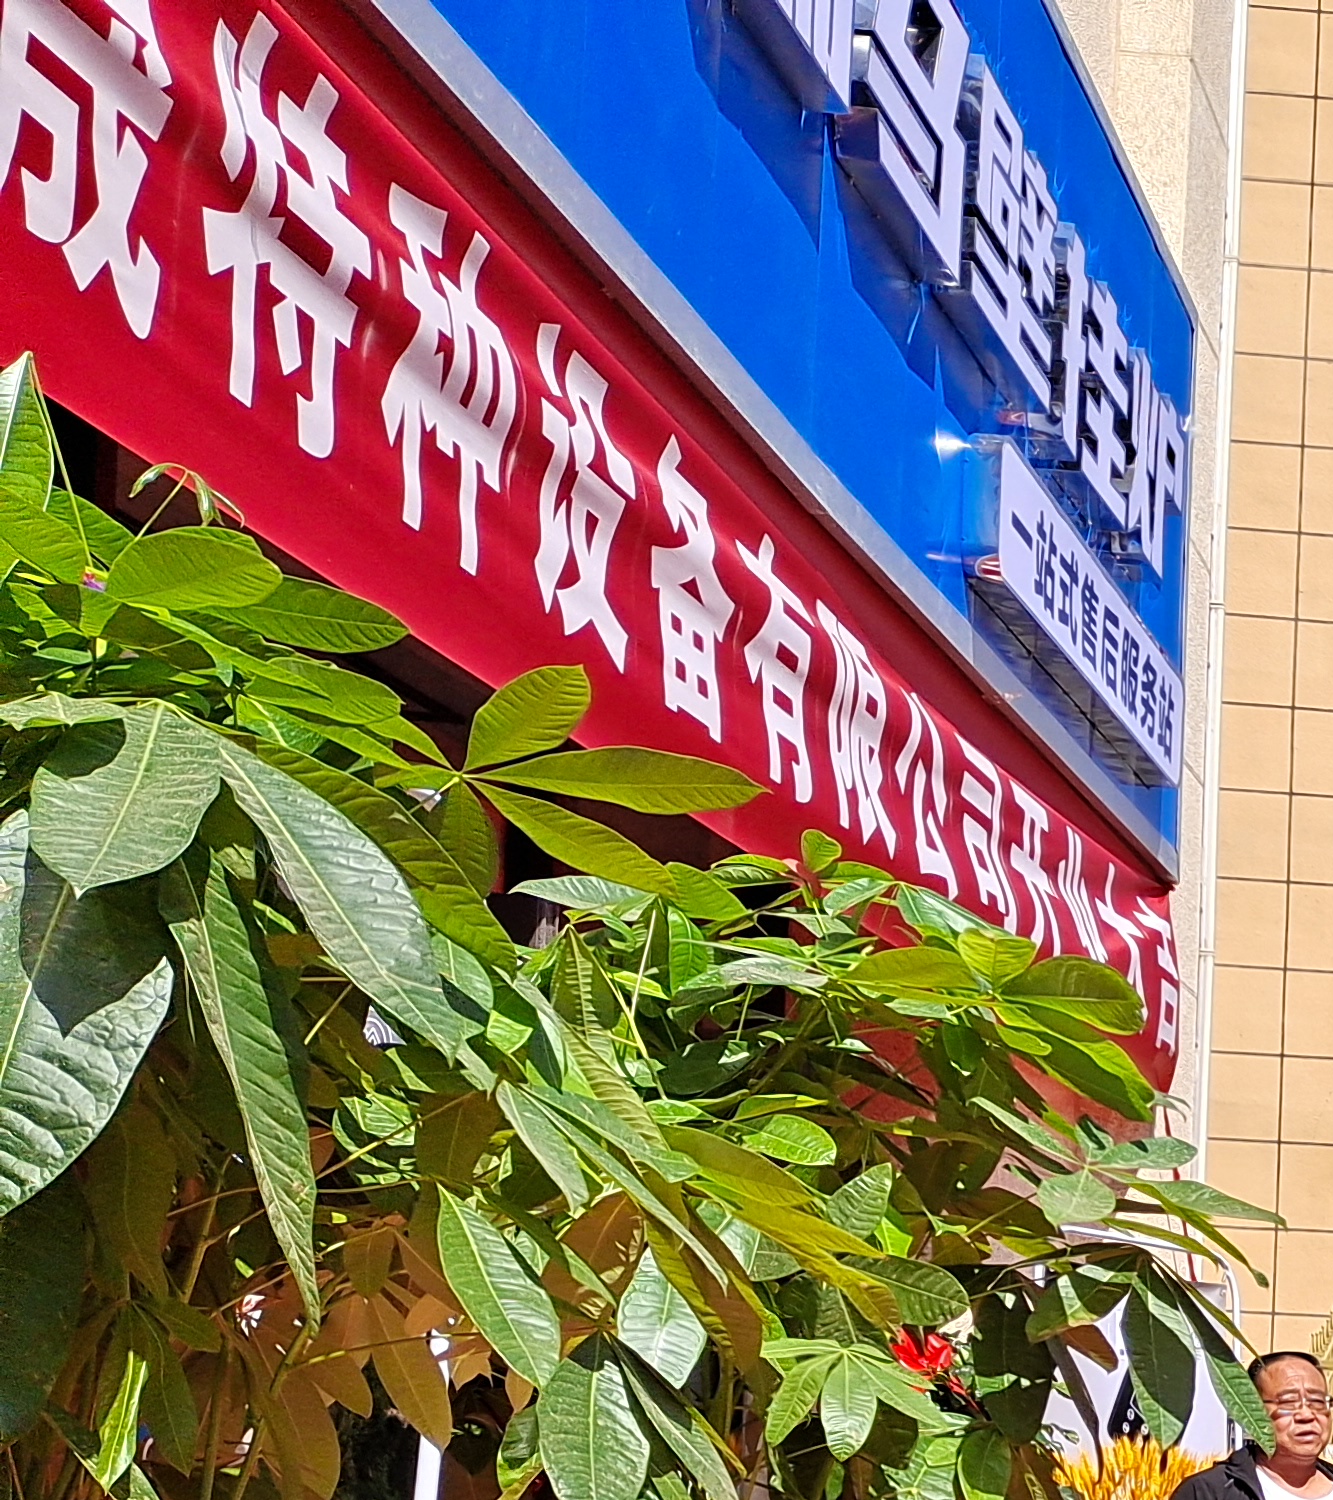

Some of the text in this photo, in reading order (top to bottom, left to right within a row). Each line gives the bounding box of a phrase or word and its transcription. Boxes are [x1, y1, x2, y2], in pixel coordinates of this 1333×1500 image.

[1011, 510, 1174, 764] 一站式售后服务站
